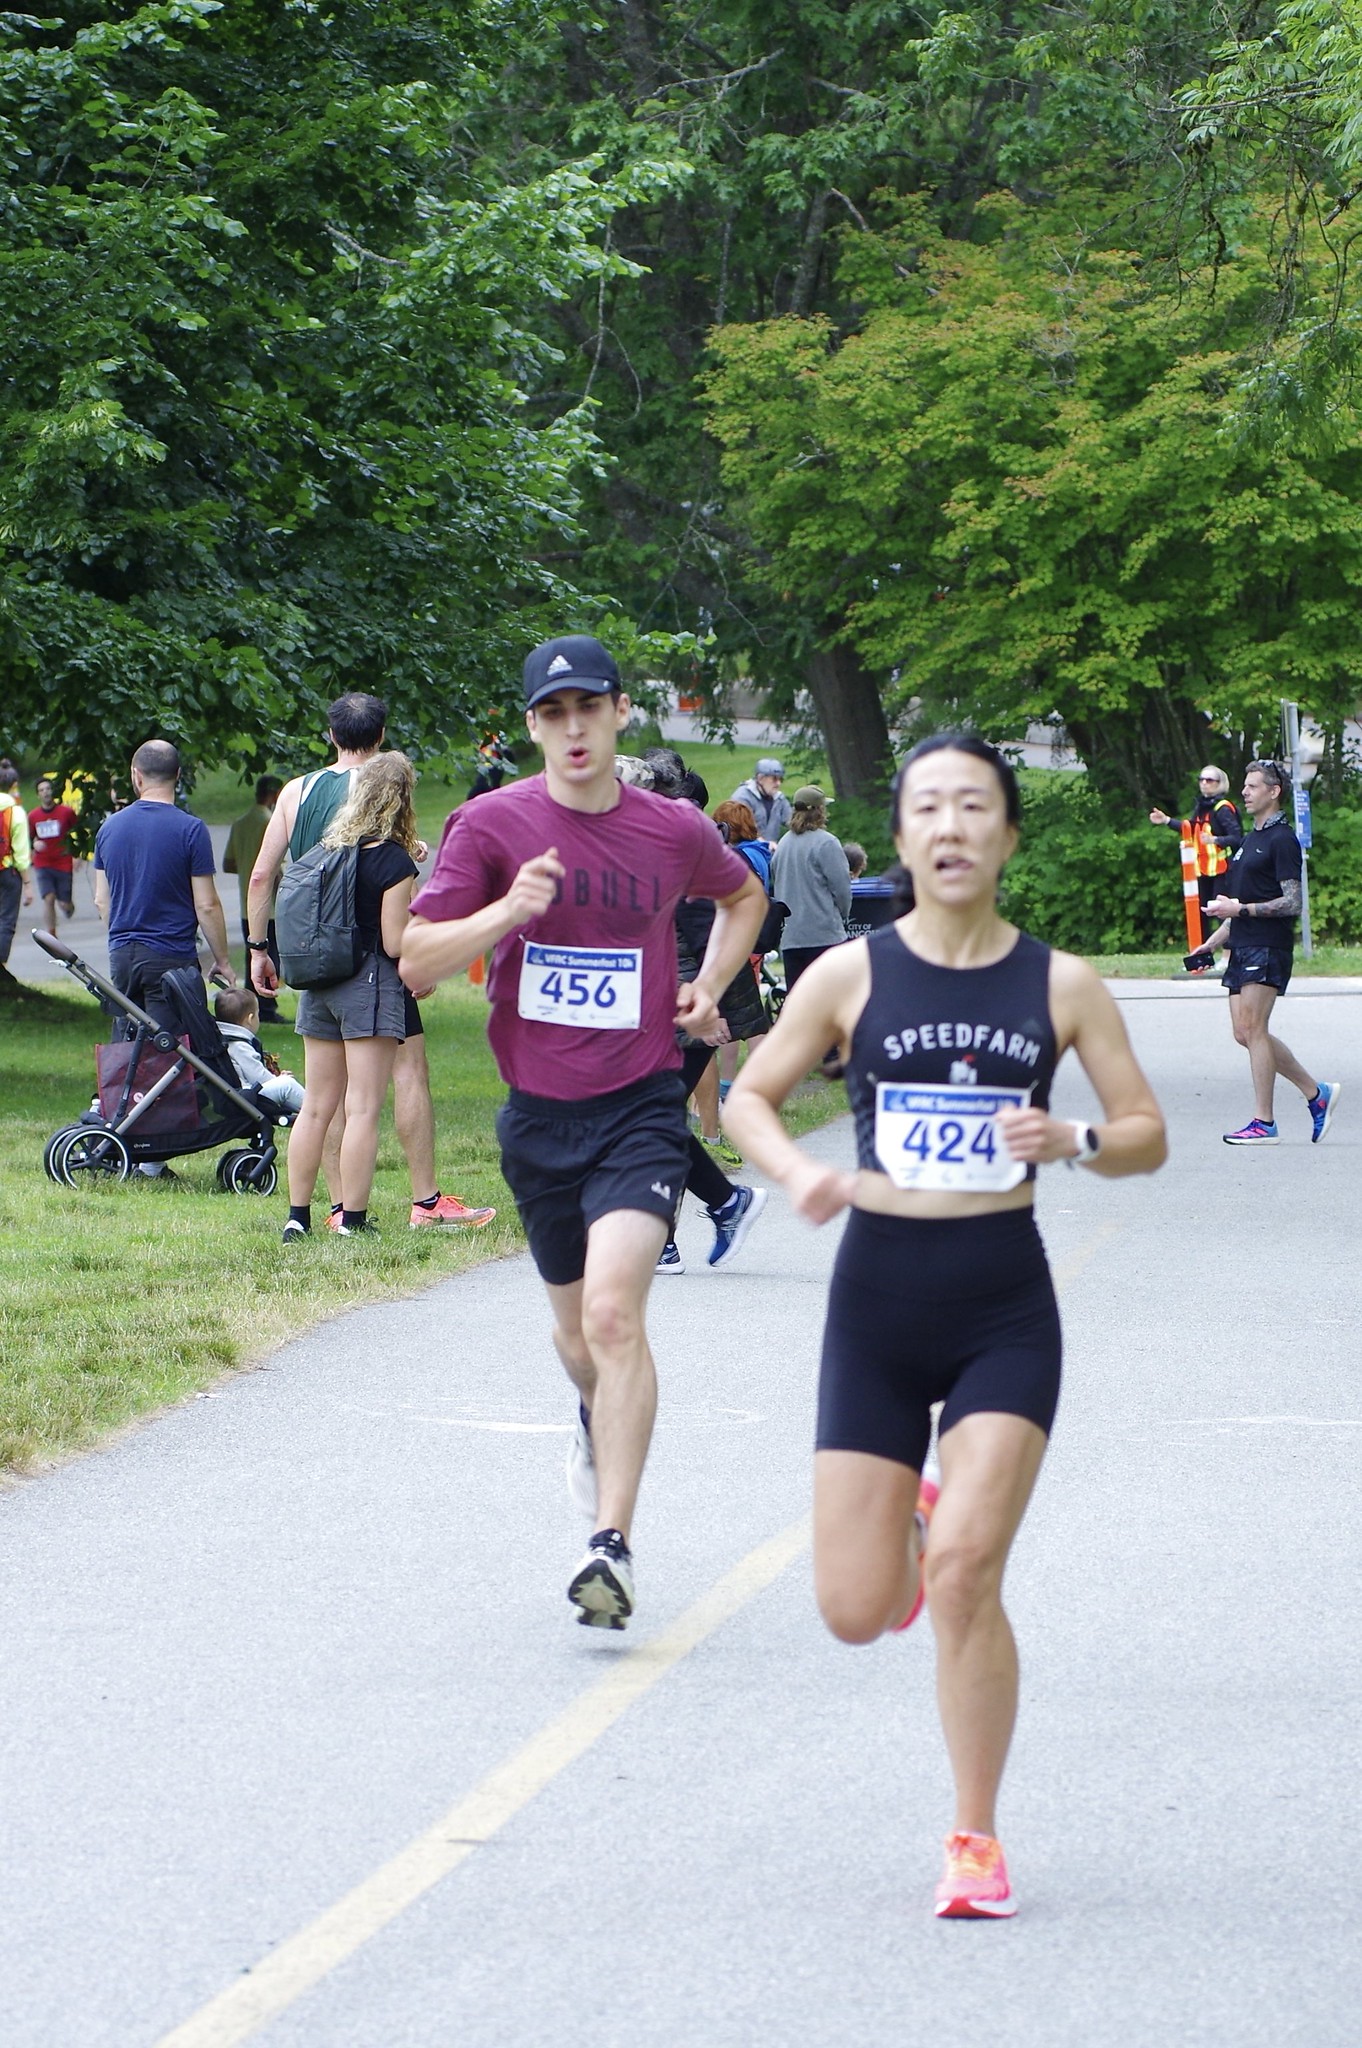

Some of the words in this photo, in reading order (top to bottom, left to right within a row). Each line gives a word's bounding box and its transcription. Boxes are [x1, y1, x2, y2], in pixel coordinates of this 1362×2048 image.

[540, 971, 617, 1009] 456
[883, 1022, 1041, 1068] SPEEDFARM
[902, 1119, 997, 1164] 424
